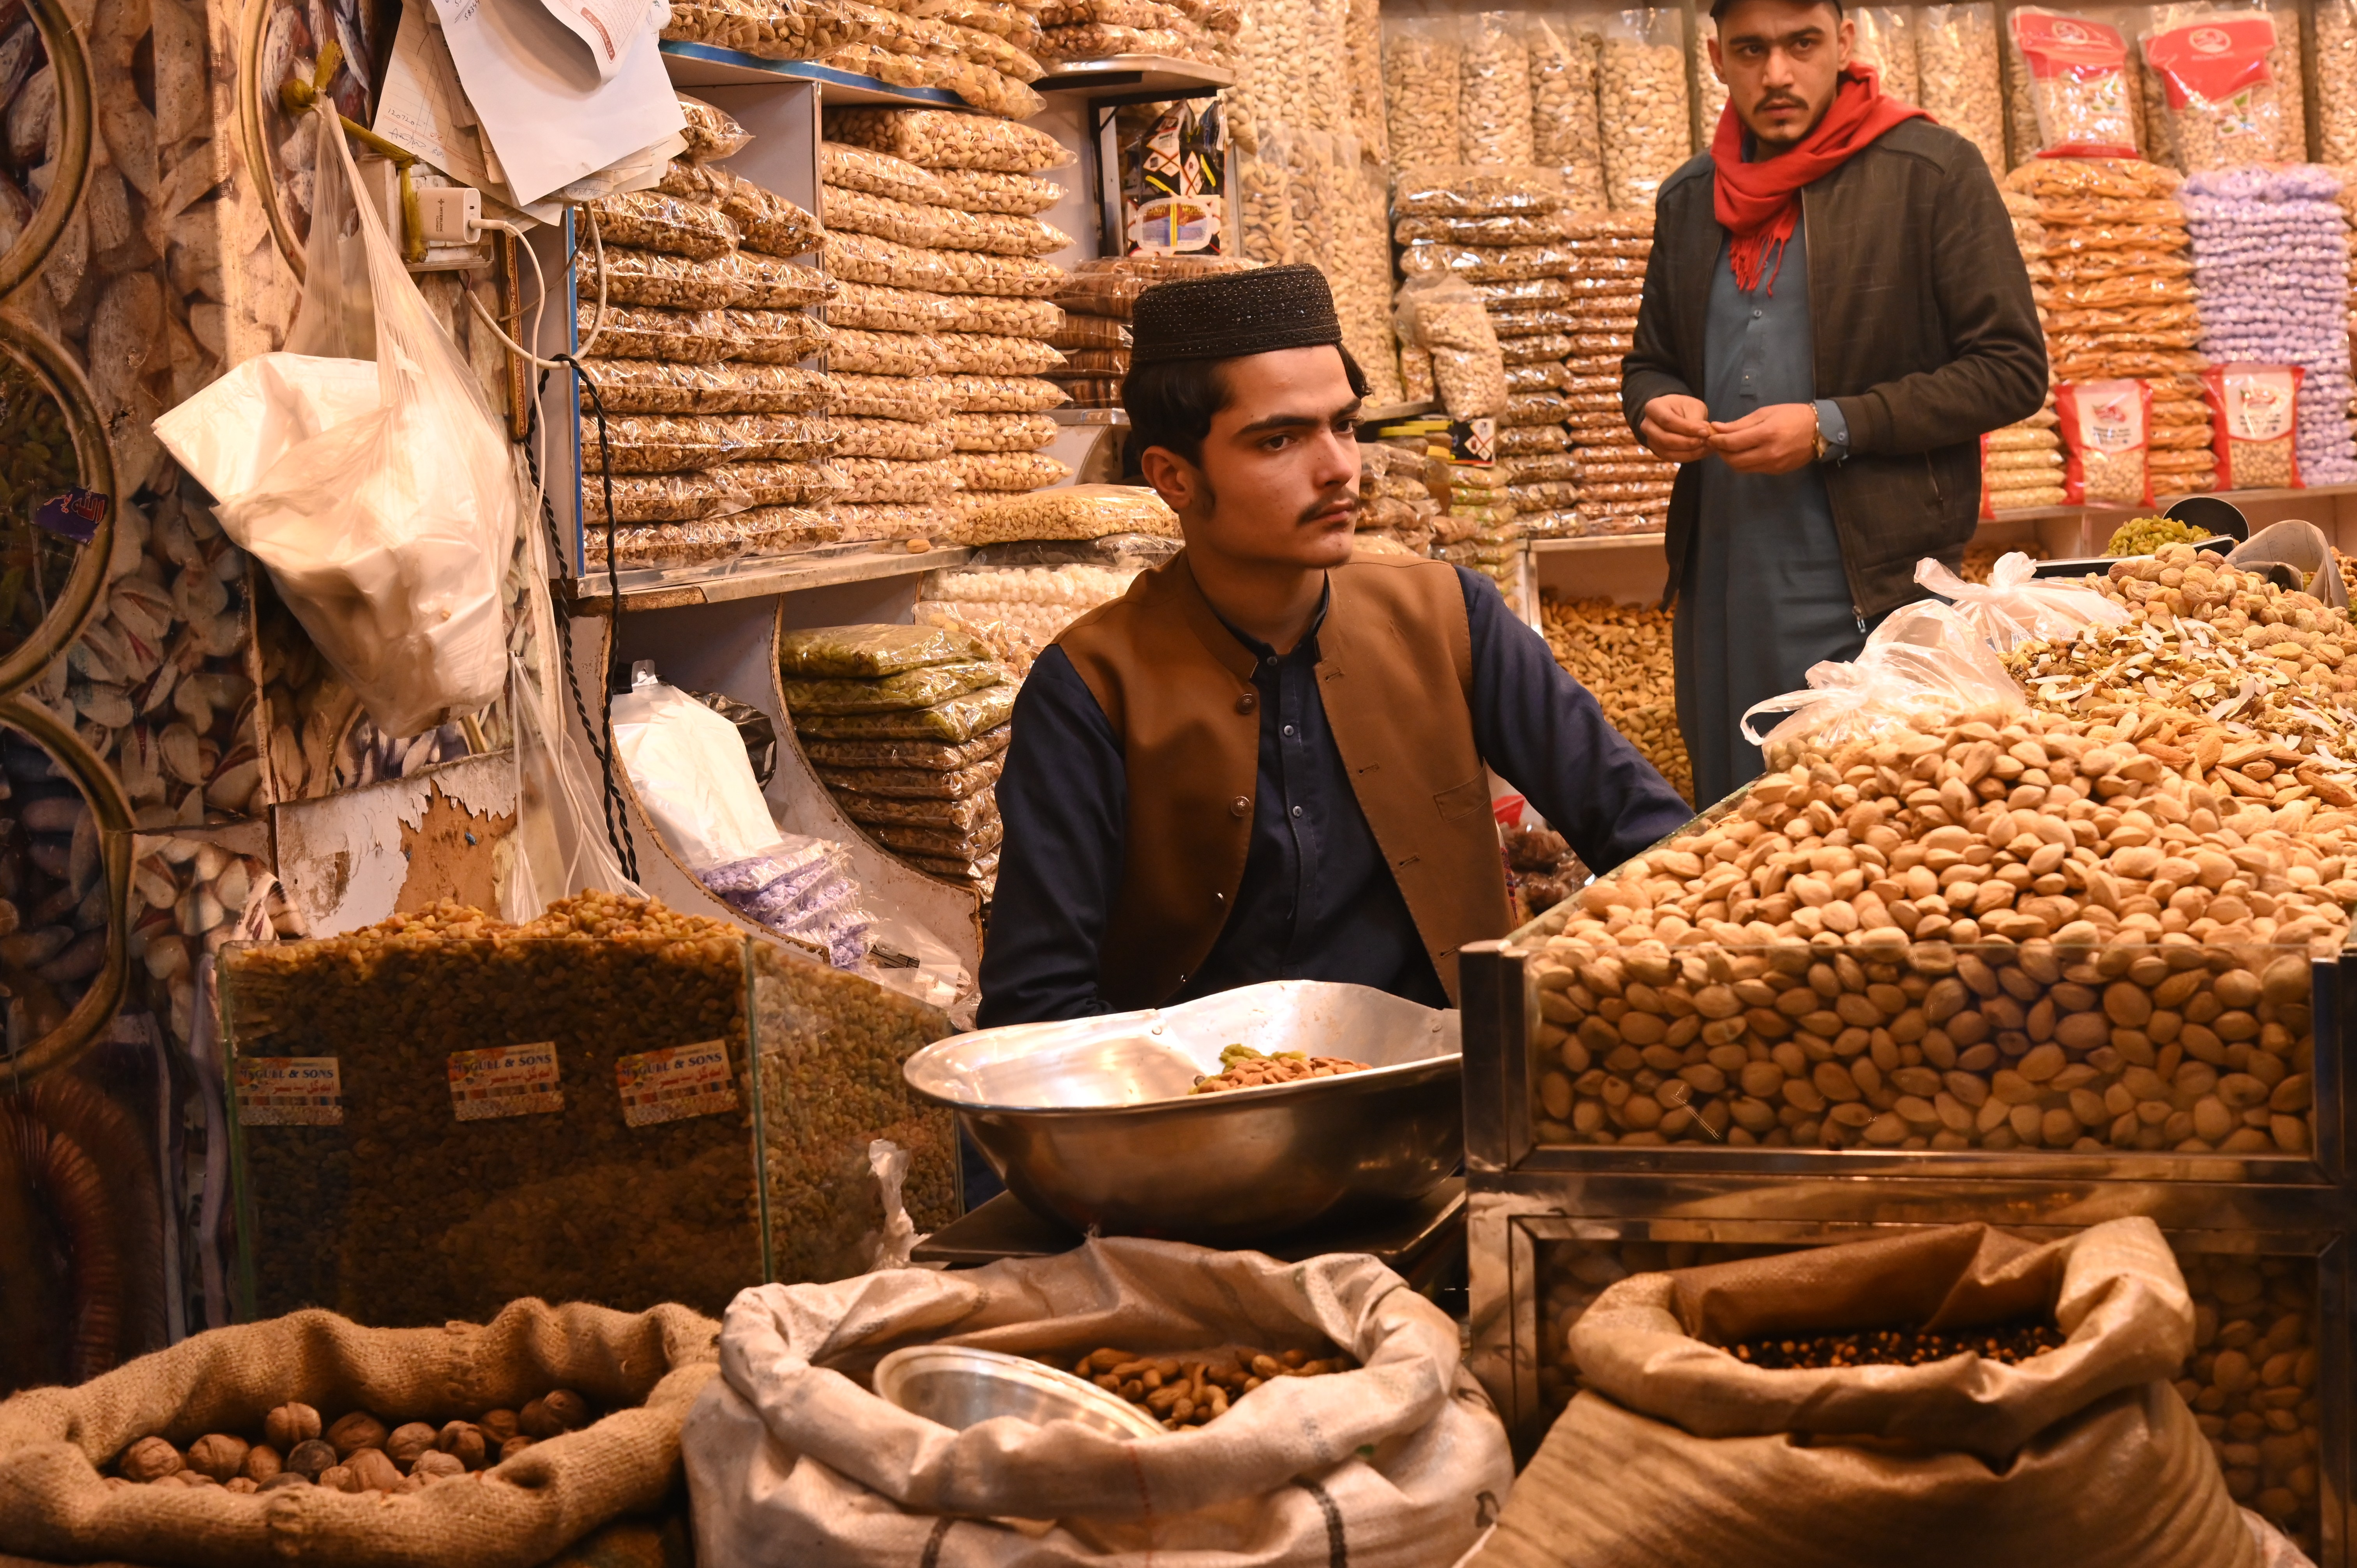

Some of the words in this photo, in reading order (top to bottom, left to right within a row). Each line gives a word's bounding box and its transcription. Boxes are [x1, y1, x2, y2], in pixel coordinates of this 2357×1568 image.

[505, 1058, 514, 1067] &
[519, 1054, 552, 1067] SONS
[674, 1059, 684, 1069] &
[689, 1053, 722, 1066] SONS
[289, 1069, 299, 1078] &
[302, 1069, 333, 1078] SONS
